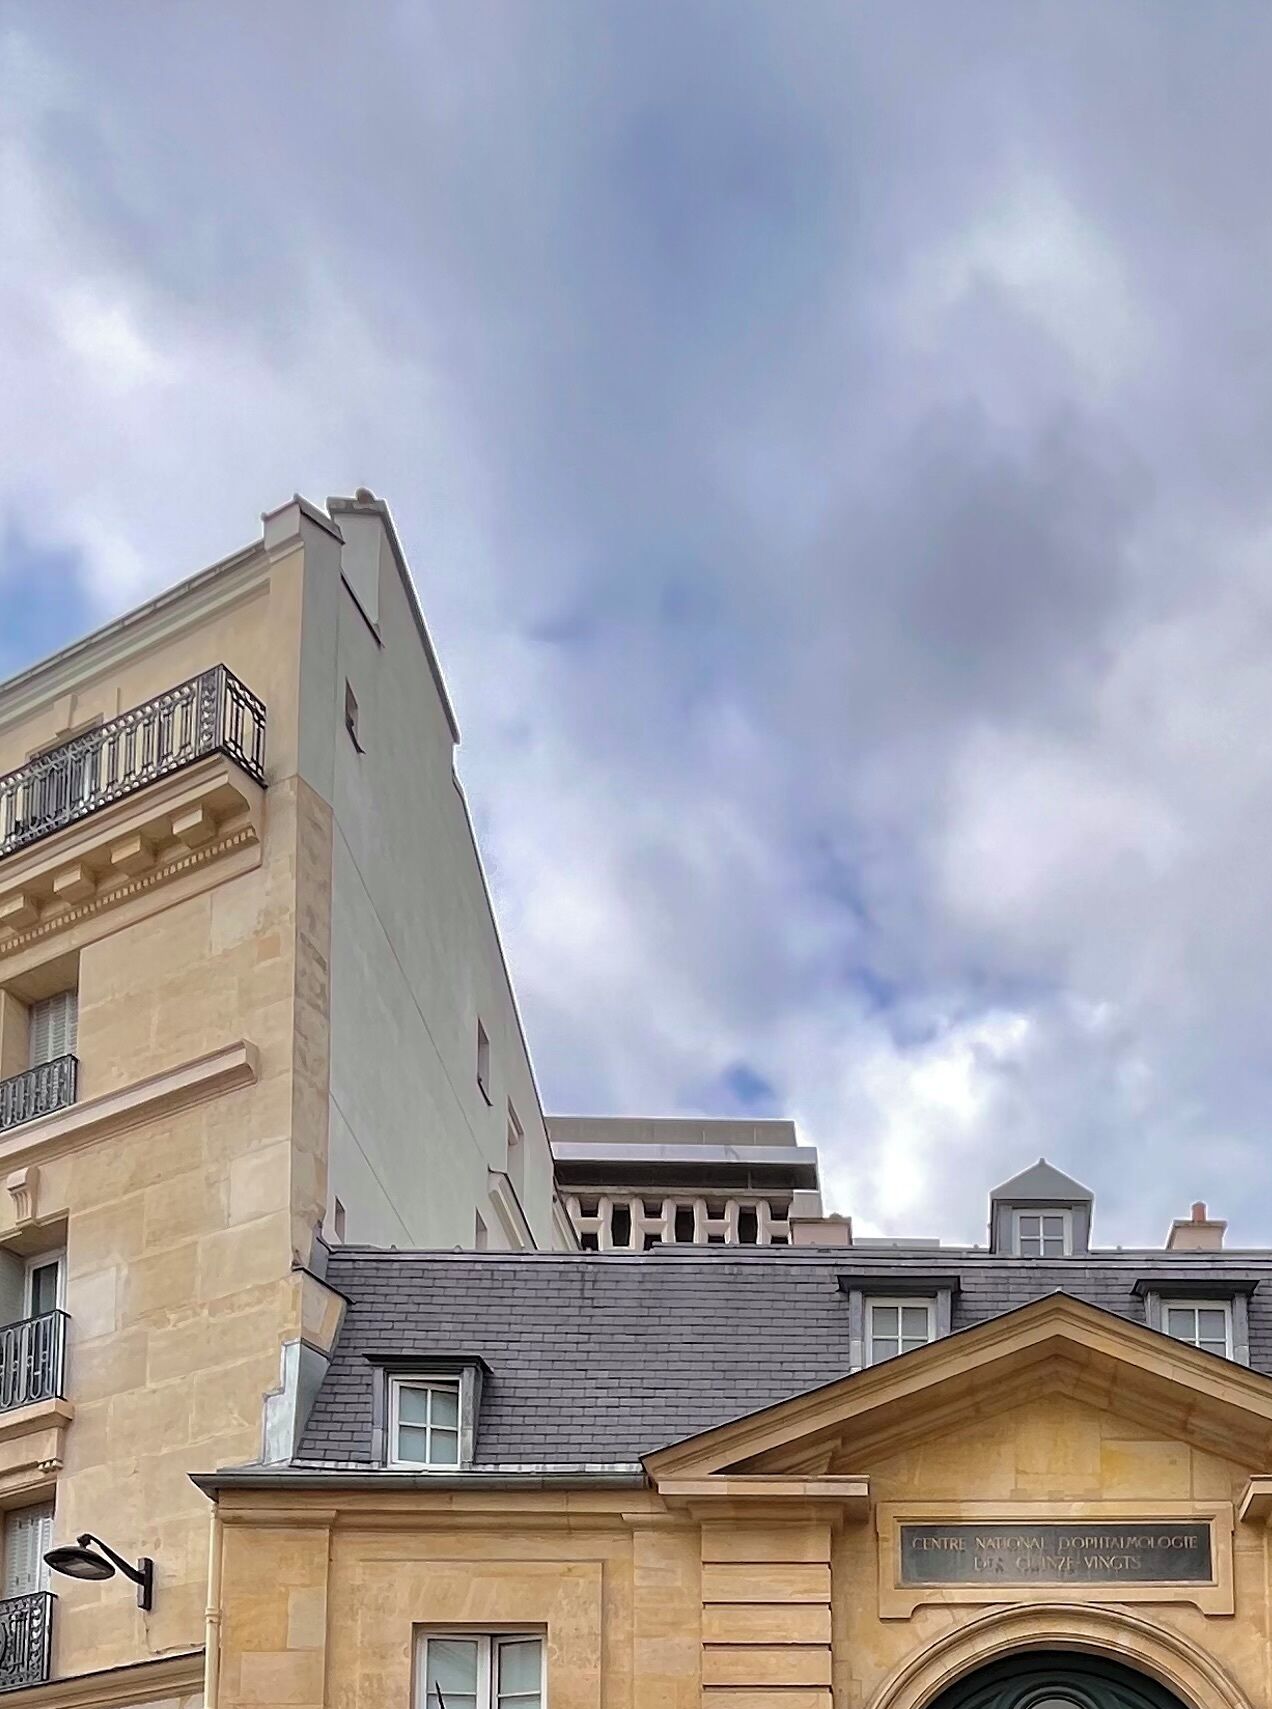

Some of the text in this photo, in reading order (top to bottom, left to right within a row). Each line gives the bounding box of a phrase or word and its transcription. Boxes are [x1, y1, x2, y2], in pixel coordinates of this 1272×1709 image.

[911, 1535, 1198, 1551] CENTRE NATIONAL D'OPHTALMOLOGIE
